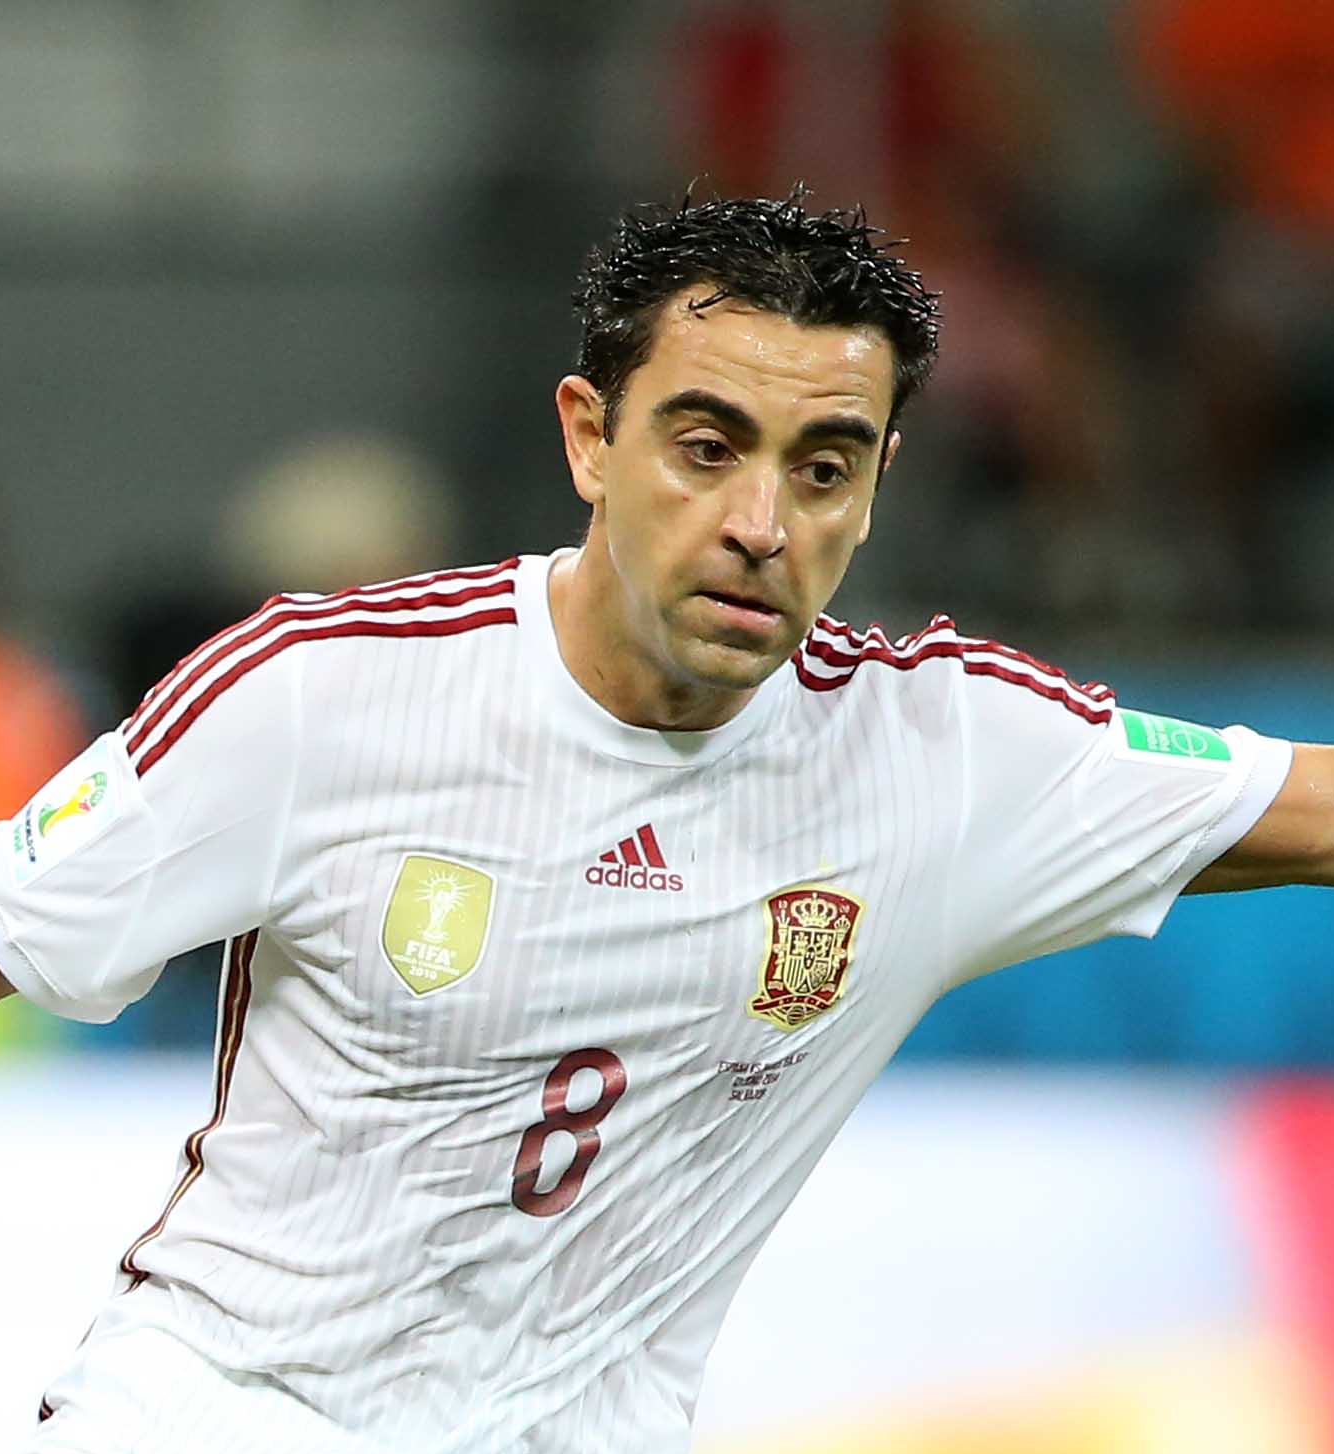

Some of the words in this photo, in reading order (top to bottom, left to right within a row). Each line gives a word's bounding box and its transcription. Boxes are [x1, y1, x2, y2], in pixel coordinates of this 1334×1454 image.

[585, 863, 684, 892] adidas
[406, 940, 451, 966] FIFA
[511, 1047, 627, 1217] 8
